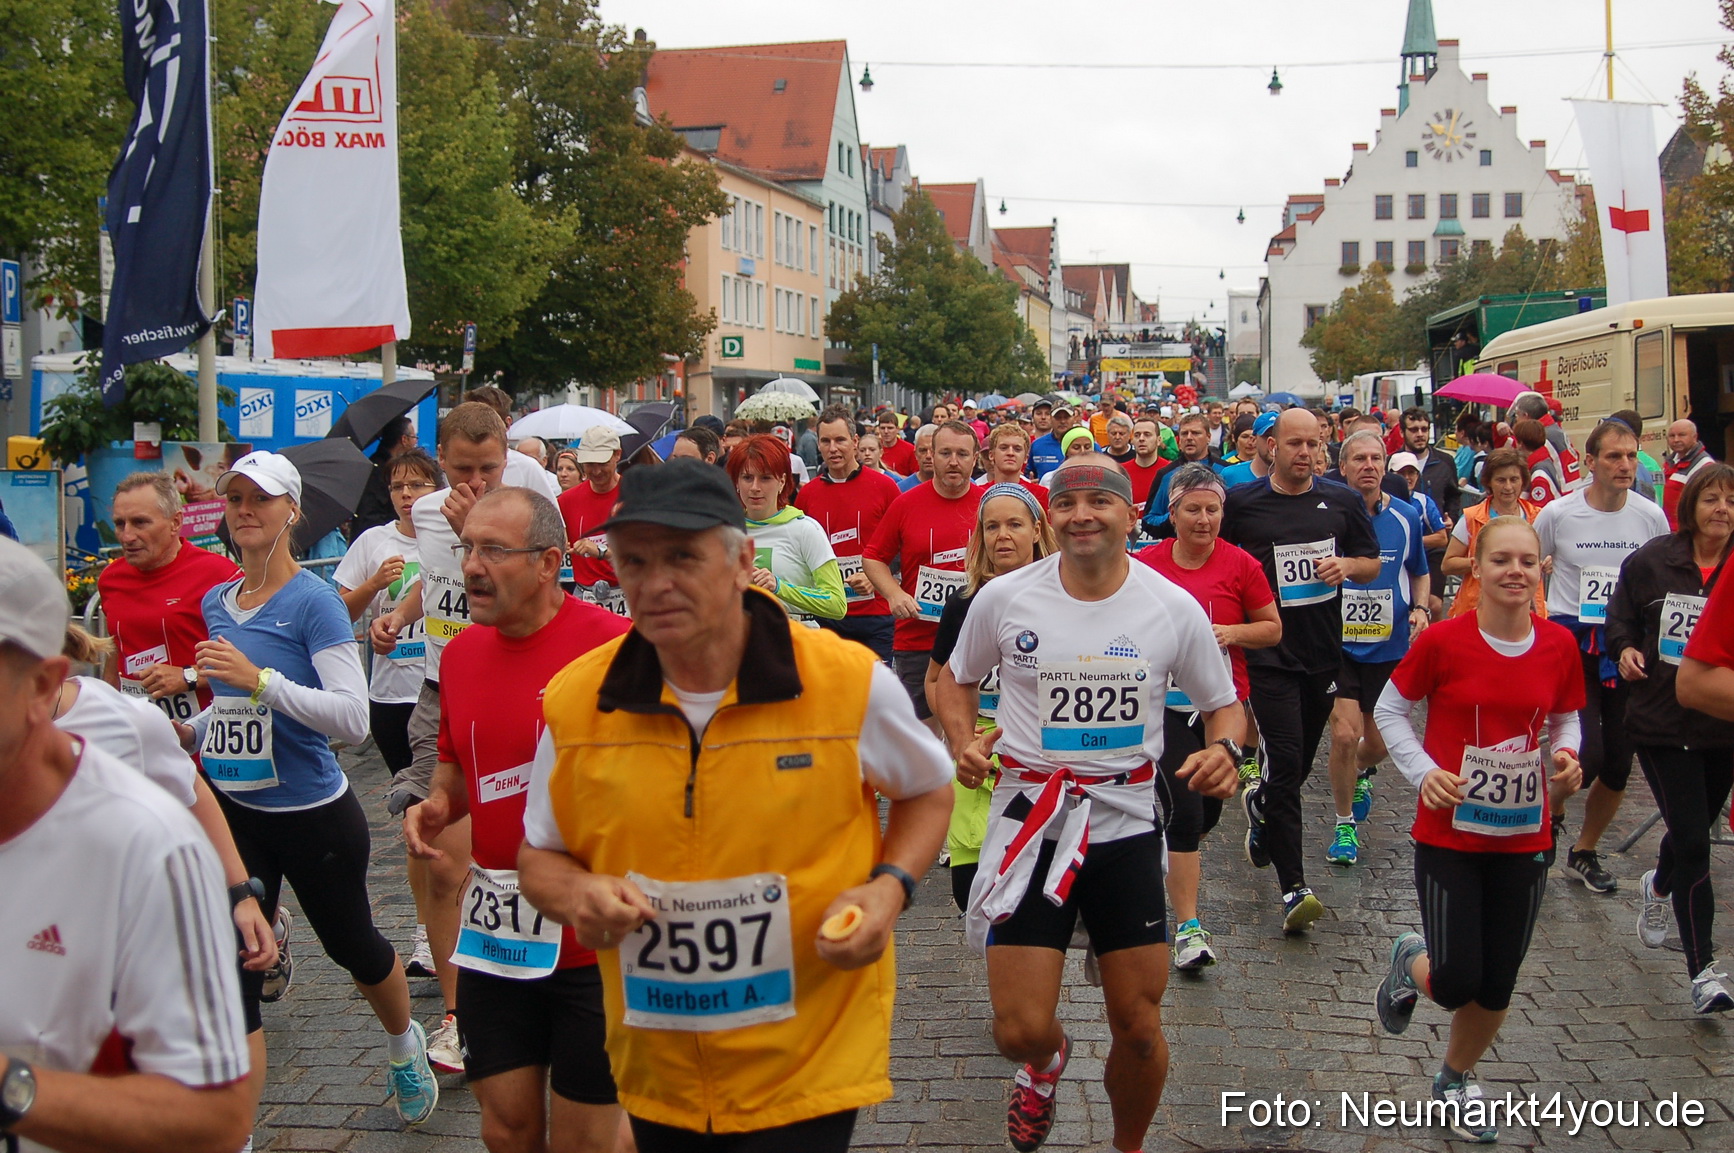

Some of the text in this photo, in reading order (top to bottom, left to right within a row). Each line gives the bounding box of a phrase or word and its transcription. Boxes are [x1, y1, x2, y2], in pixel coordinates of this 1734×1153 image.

[5, 269, 16, 315] P
[237, 303, 247, 331] P
[724, 338, 741, 355] D
[1558, 350, 1608, 377] Bayerisches
[1557, 380, 1580, 398] Rotes
[1562, 406, 1579, 421] reuz
[1576, 541, 1639, 549] www.hasit.de
[942, 552, 958, 560] DEHN
[1276, 550, 1299, 559] PARTL
[428, 574, 451, 586] PARTL
[919, 571, 964, 583] PARTL Neumarkt
[1587, 580, 1618, 600] 24
[381, 606, 397, 614] PAR
[596, 601, 627, 616] 14
[1345, 603, 1382, 622] 232
[1666, 600, 1690, 609] PARTL
[443, 624, 467, 637] Stef
[1344, 627, 1381, 635] Johannes
[135, 654, 155, 667] DEHN
[1040, 671, 1131, 681] PARTL Neumarkt
[148, 694, 192, 720] 06
[217, 705, 254, 716] Neumarkt
[1050, 687, 1139, 722] 2825
[206, 720, 263, 754] 2050
[1081, 732, 1107, 746] Can
[218, 764, 240, 777] Alex
[1465, 755, 1534, 770] PARTL Neumarkt
[495, 774, 520, 791] DEHN
[1467, 769, 1537, 804] 2319
[1473, 809, 1528, 825] Katharina
[673, 893, 756, 912] Neumarkt
[26, 940, 67, 956] adidas
[483, 940, 528, 962] Helmut
[634, 911, 772, 975] 2597
[647, 983, 765, 1010] Herbert A.
